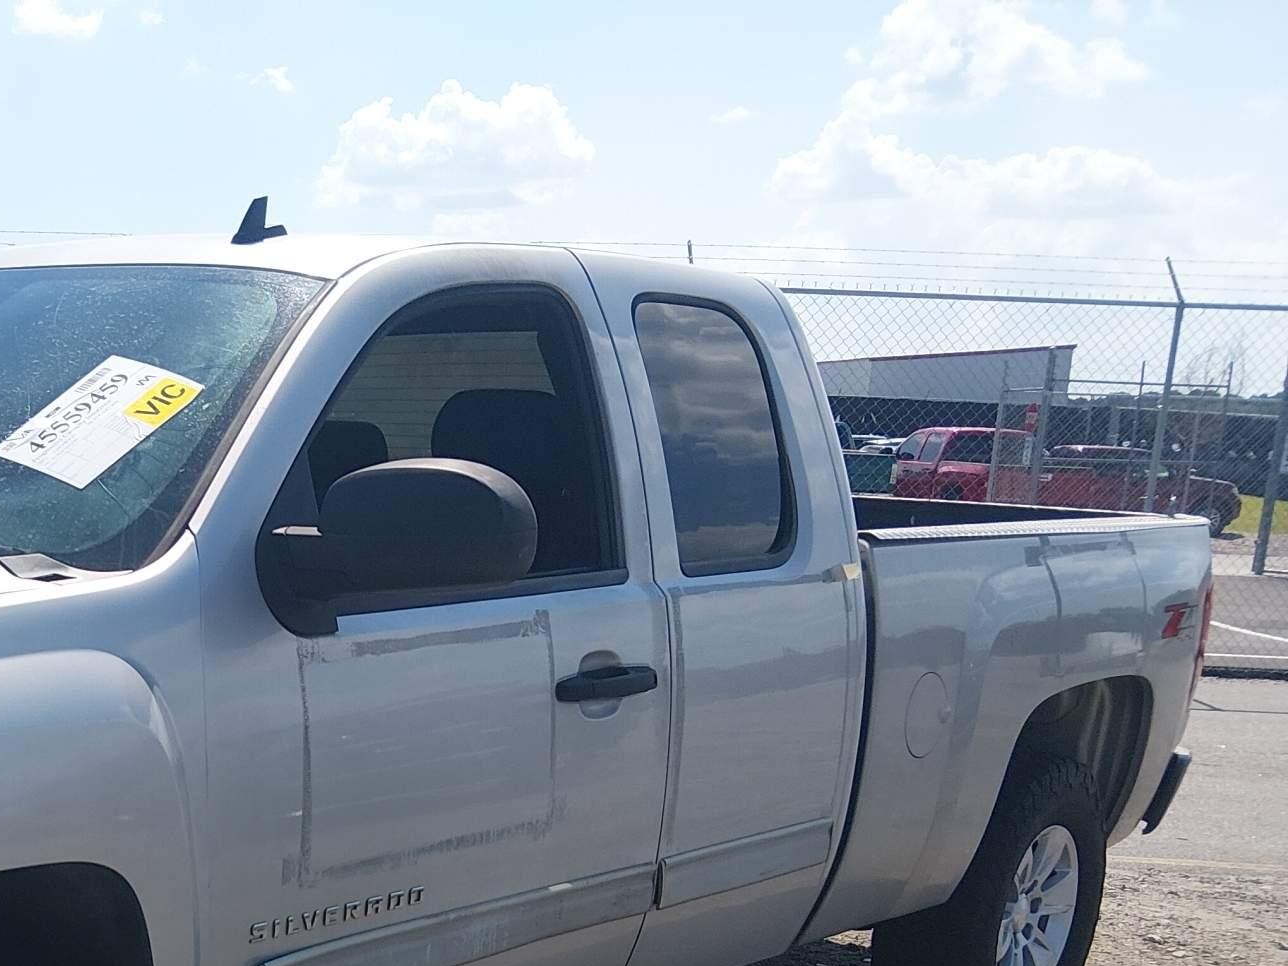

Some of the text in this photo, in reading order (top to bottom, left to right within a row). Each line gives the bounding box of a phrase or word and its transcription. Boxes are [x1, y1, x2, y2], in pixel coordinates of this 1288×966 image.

[29, 373, 129, 454] 45559459
[134, 383, 186, 416] VIC
[248, 885, 425, 944] SILVERADO
